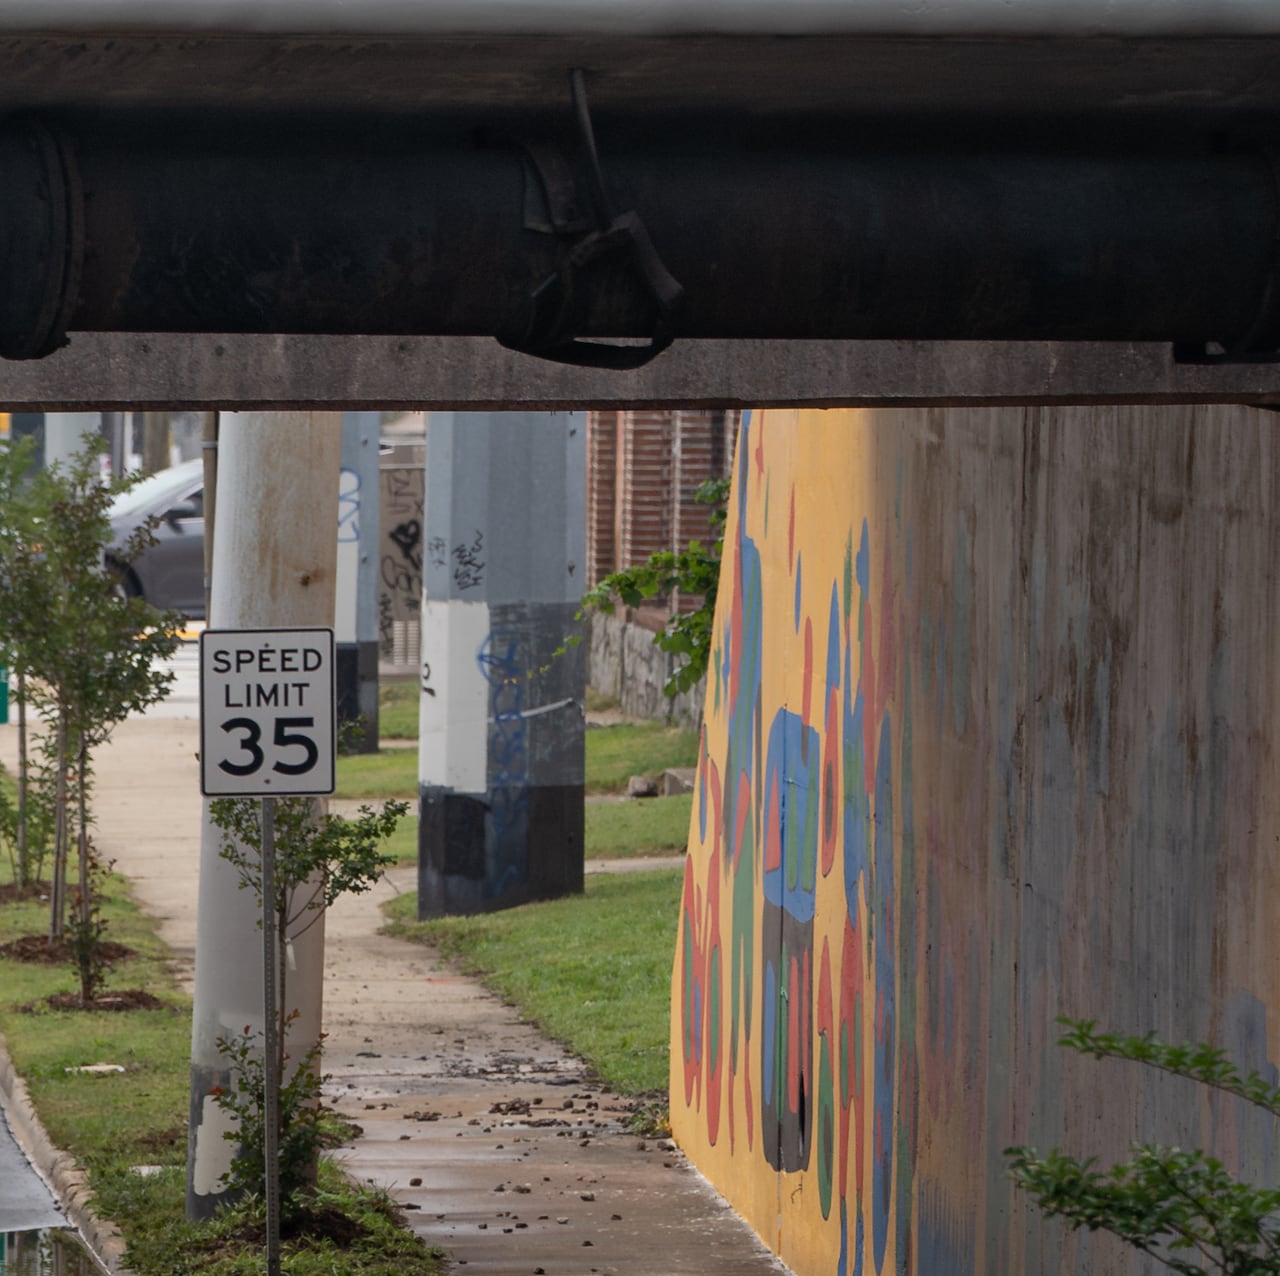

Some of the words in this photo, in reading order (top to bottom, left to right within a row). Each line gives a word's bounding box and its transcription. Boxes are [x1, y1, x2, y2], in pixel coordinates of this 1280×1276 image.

[213, 648, 322, 673] SPEED
[225, 683, 310, 707] LIMIT
[218, 717, 318, 776] 35
